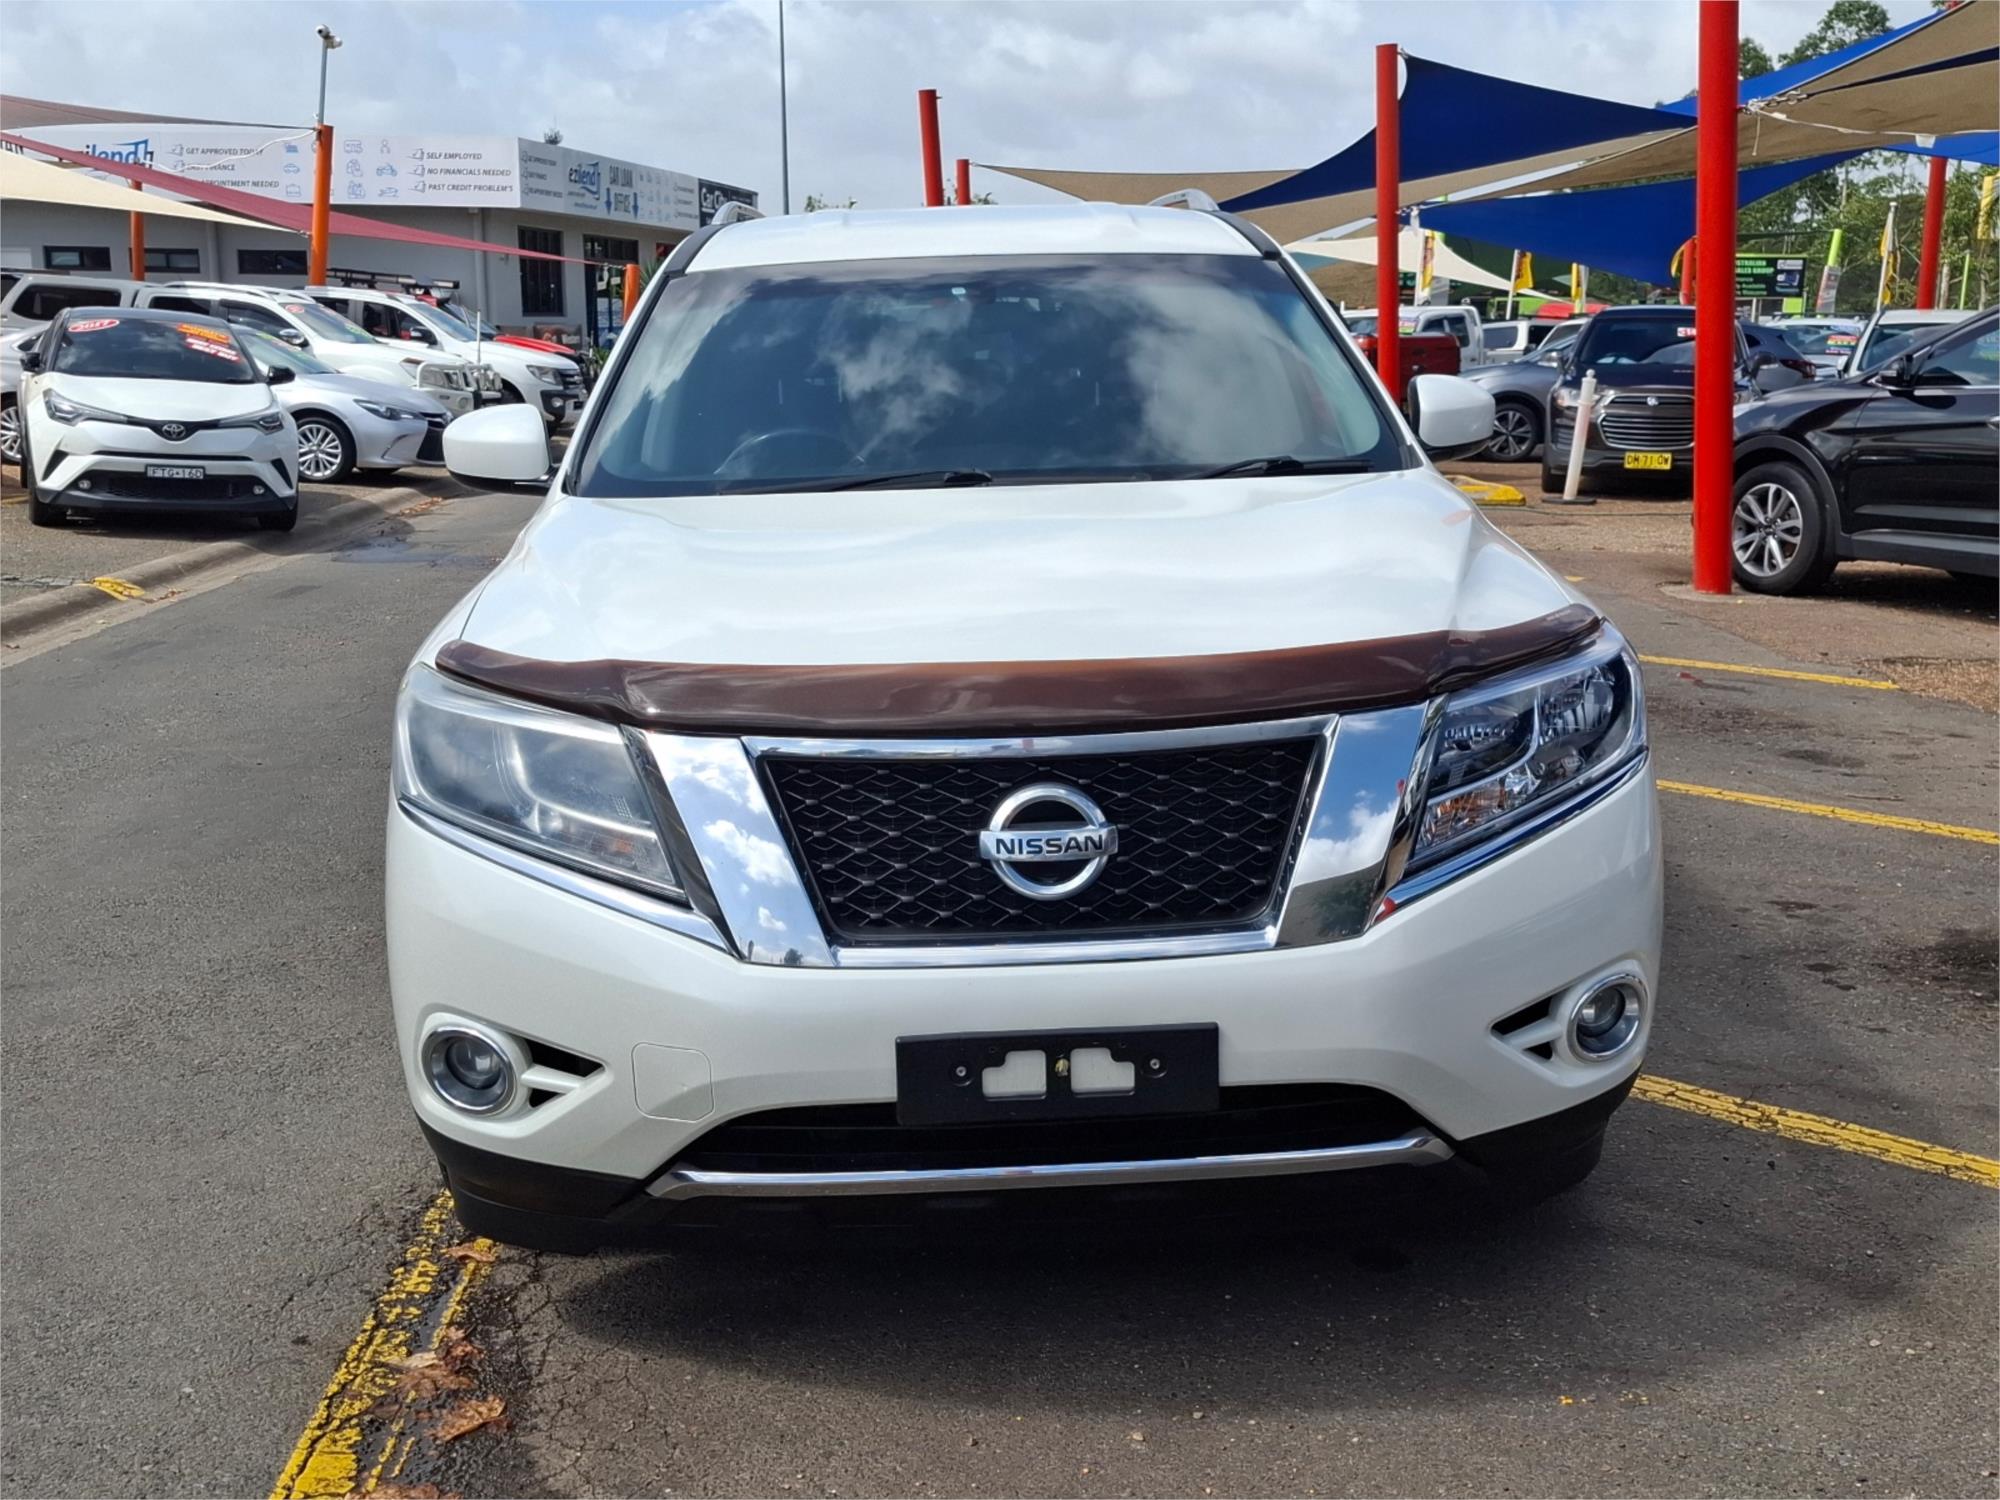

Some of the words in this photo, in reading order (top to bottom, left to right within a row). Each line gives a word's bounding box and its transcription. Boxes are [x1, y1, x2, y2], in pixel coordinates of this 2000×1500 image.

[186, 147, 199, 155] GET
[200, 147, 238, 156] APPROVED
[426, 151, 443, 160] SELF
[443, 152, 483, 161] EMPLOYED
[427, 167, 439, 176] NO
[439, 167, 481, 177] FINANCIALS
[482, 168, 512, 177] NEEDED
[251, 180, 280, 189] NEEDED
[428, 183, 446, 192] PAST
[446, 183, 472, 192] CREDIT
[473, 184, 514, 193] PROBLEM'S
[995, 834, 1104, 855] NISSAN
